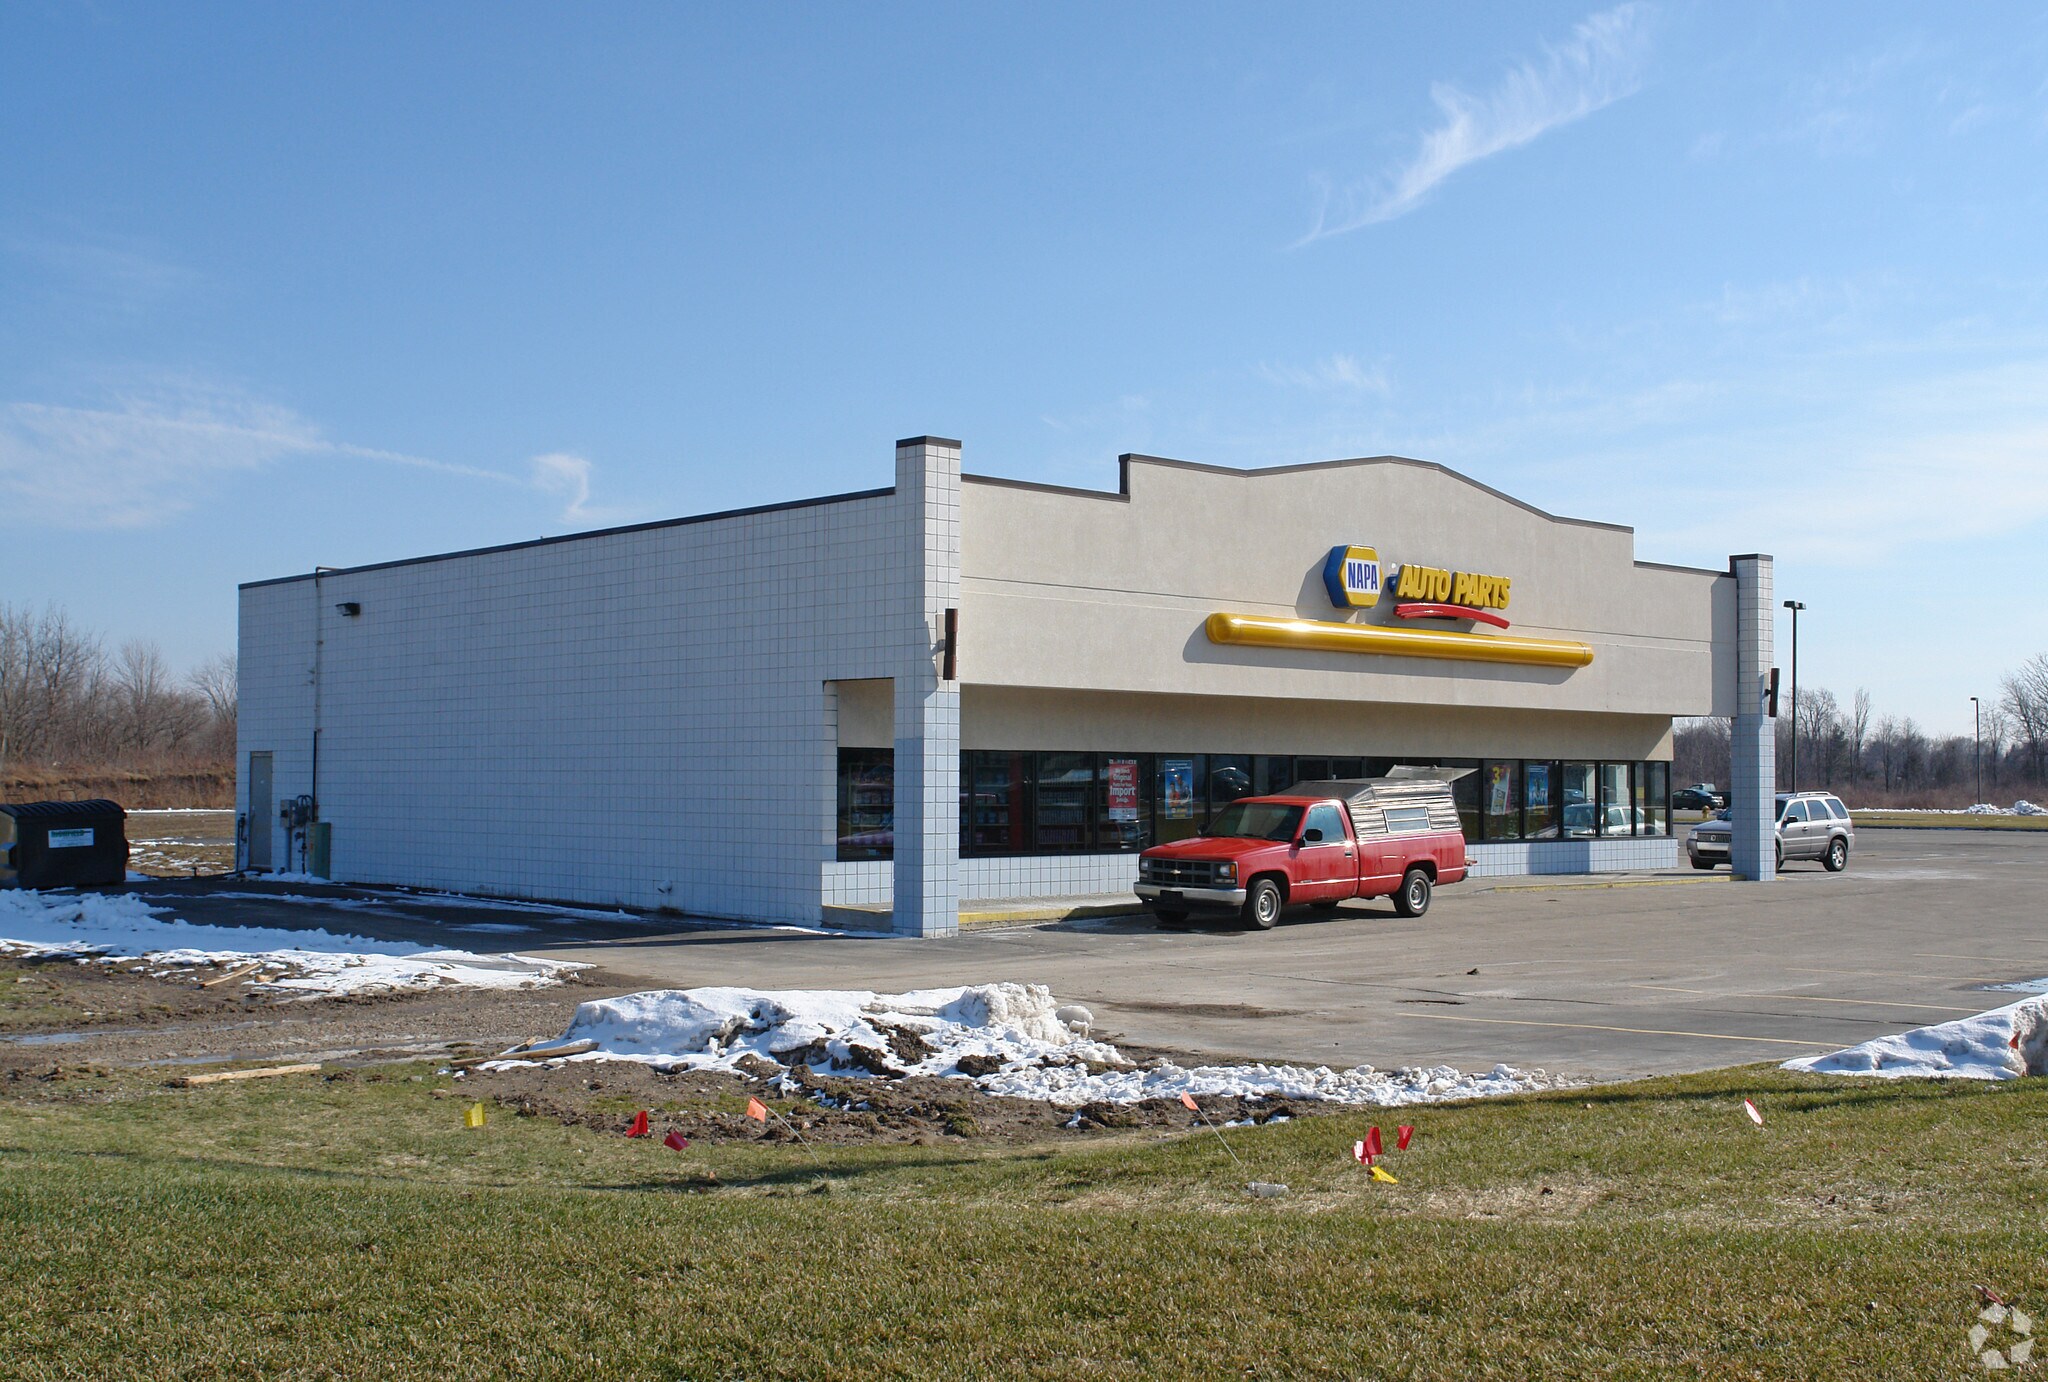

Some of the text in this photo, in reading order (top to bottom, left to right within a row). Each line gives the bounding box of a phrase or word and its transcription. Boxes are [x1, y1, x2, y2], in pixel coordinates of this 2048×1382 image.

[1347, 561, 1378, 591] NAPA
[1396, 564, 1511, 609] AUTO PARTS
[1109, 785, 1136, 797] Import
